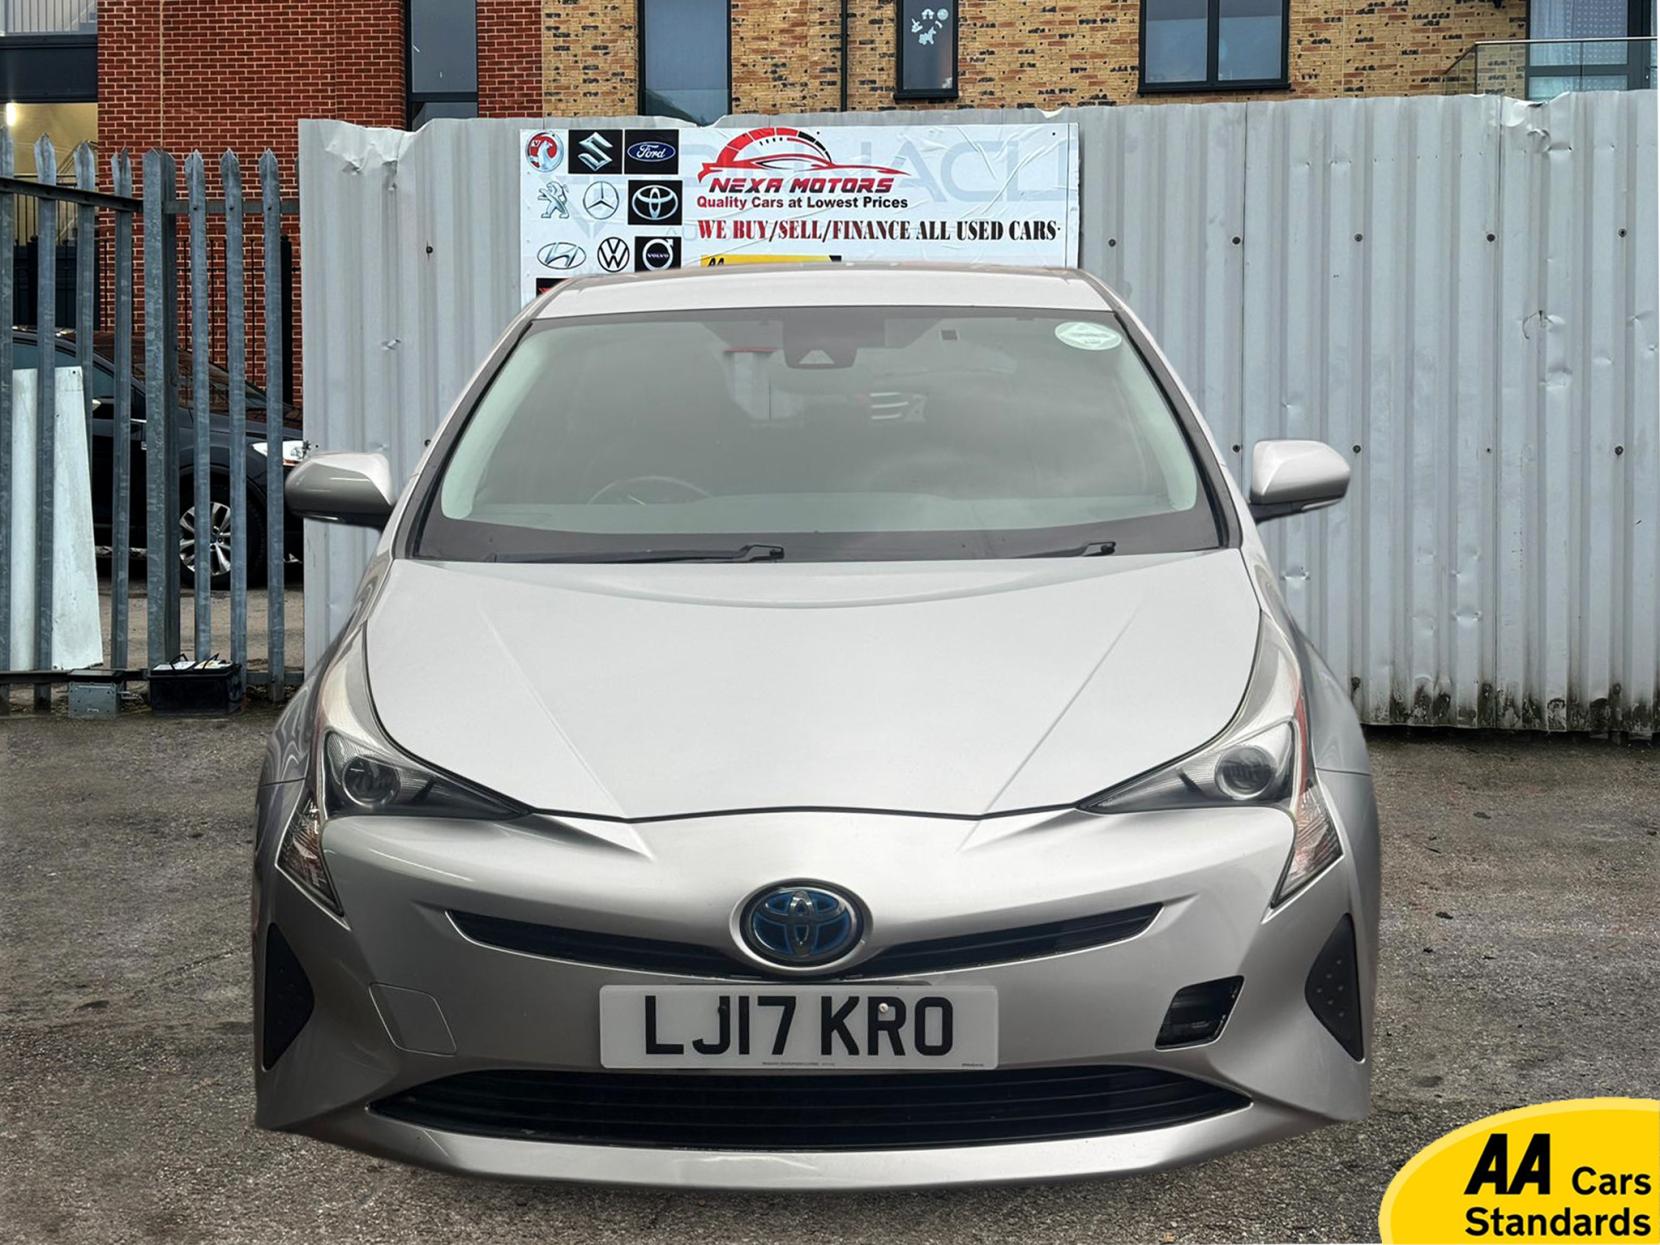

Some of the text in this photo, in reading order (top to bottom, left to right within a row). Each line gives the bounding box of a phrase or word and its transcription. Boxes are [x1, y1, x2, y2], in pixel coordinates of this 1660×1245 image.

[636, 144, 667, 159] Ford
[708, 178, 894, 194] NEXA MOTORS
[697, 195, 909, 210] Quality Cars at Lowest Prices
[697, 220, 727, 240] WE
[916, 220, 950, 240] ALL
[956, 220, 1004, 240] USED
[1009, 220, 1057, 240] CARS
[644, 995, 954, 1056] LJ17 KRO
